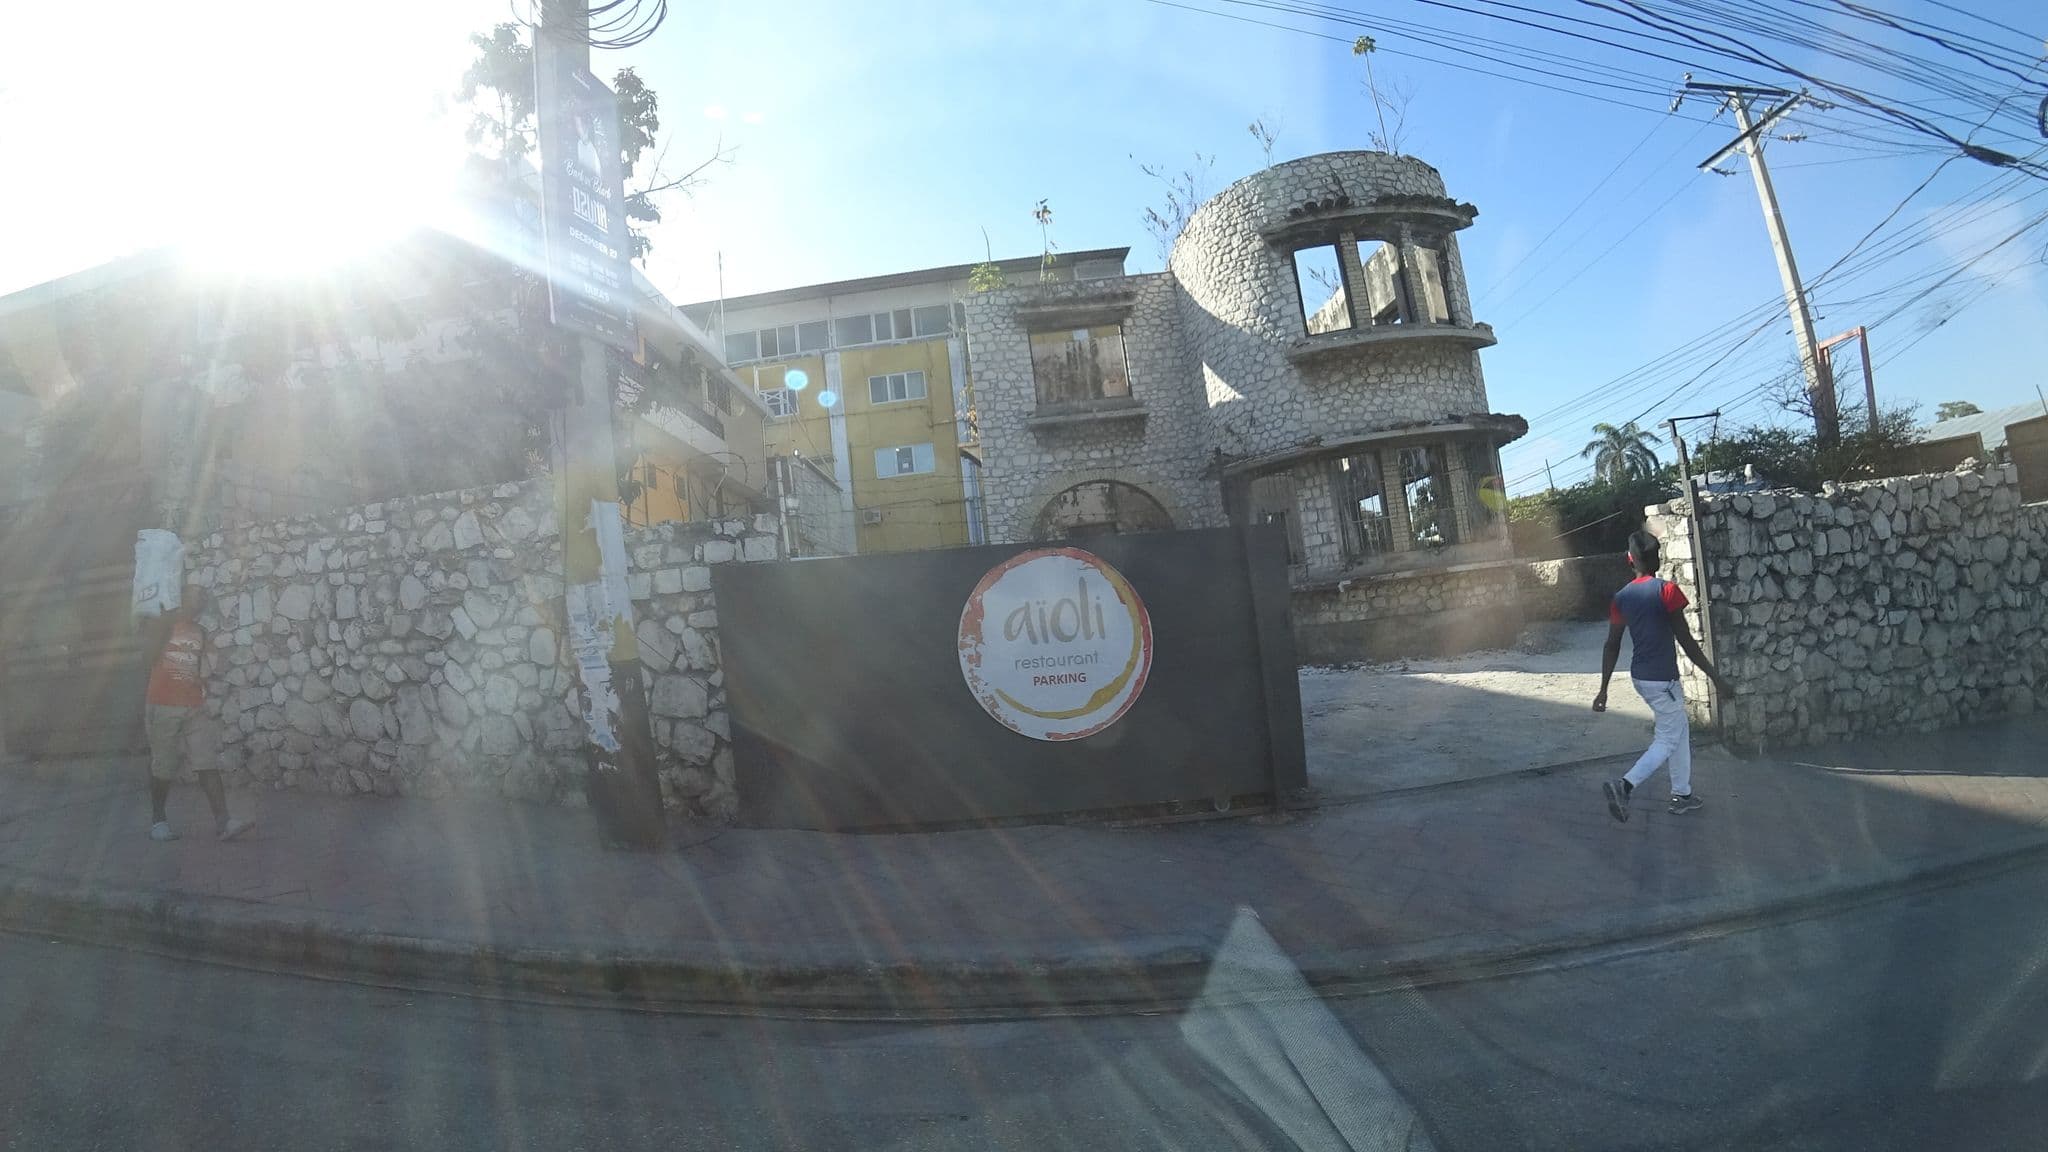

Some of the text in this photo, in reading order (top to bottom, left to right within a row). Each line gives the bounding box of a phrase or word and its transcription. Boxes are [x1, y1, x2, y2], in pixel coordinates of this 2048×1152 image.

[1004, 576, 1106, 645] aïoli
[1014, 650, 1099, 671] restaurant
[1033, 672, 1087, 687] PARKING
